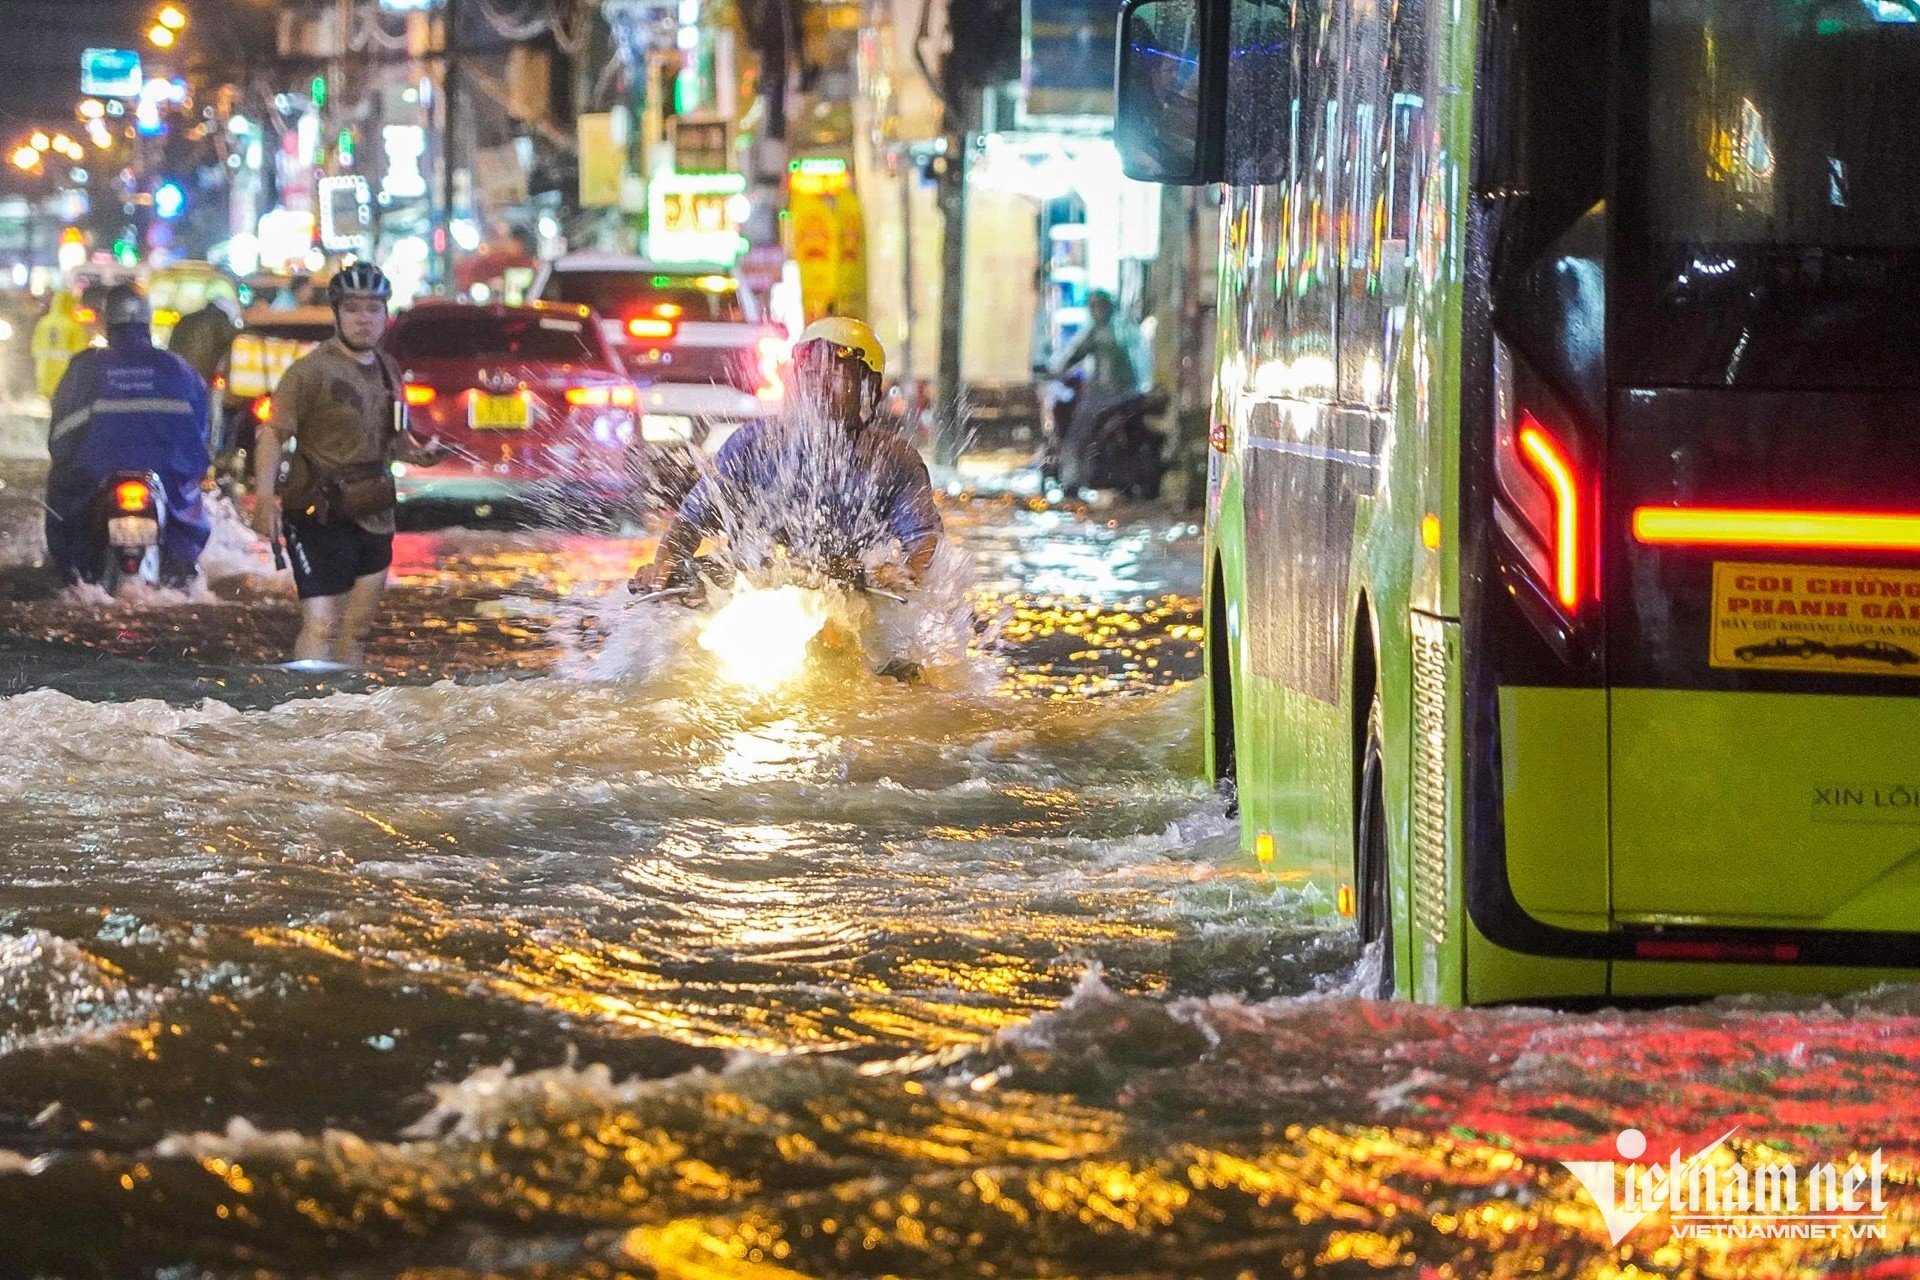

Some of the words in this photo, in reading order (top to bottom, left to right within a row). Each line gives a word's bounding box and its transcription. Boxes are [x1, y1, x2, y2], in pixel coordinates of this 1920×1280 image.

[1735, 575, 1794, 593] COI
[1727, 597, 1848, 618] PHANH
[1813, 788, 1863, 806] XIN
